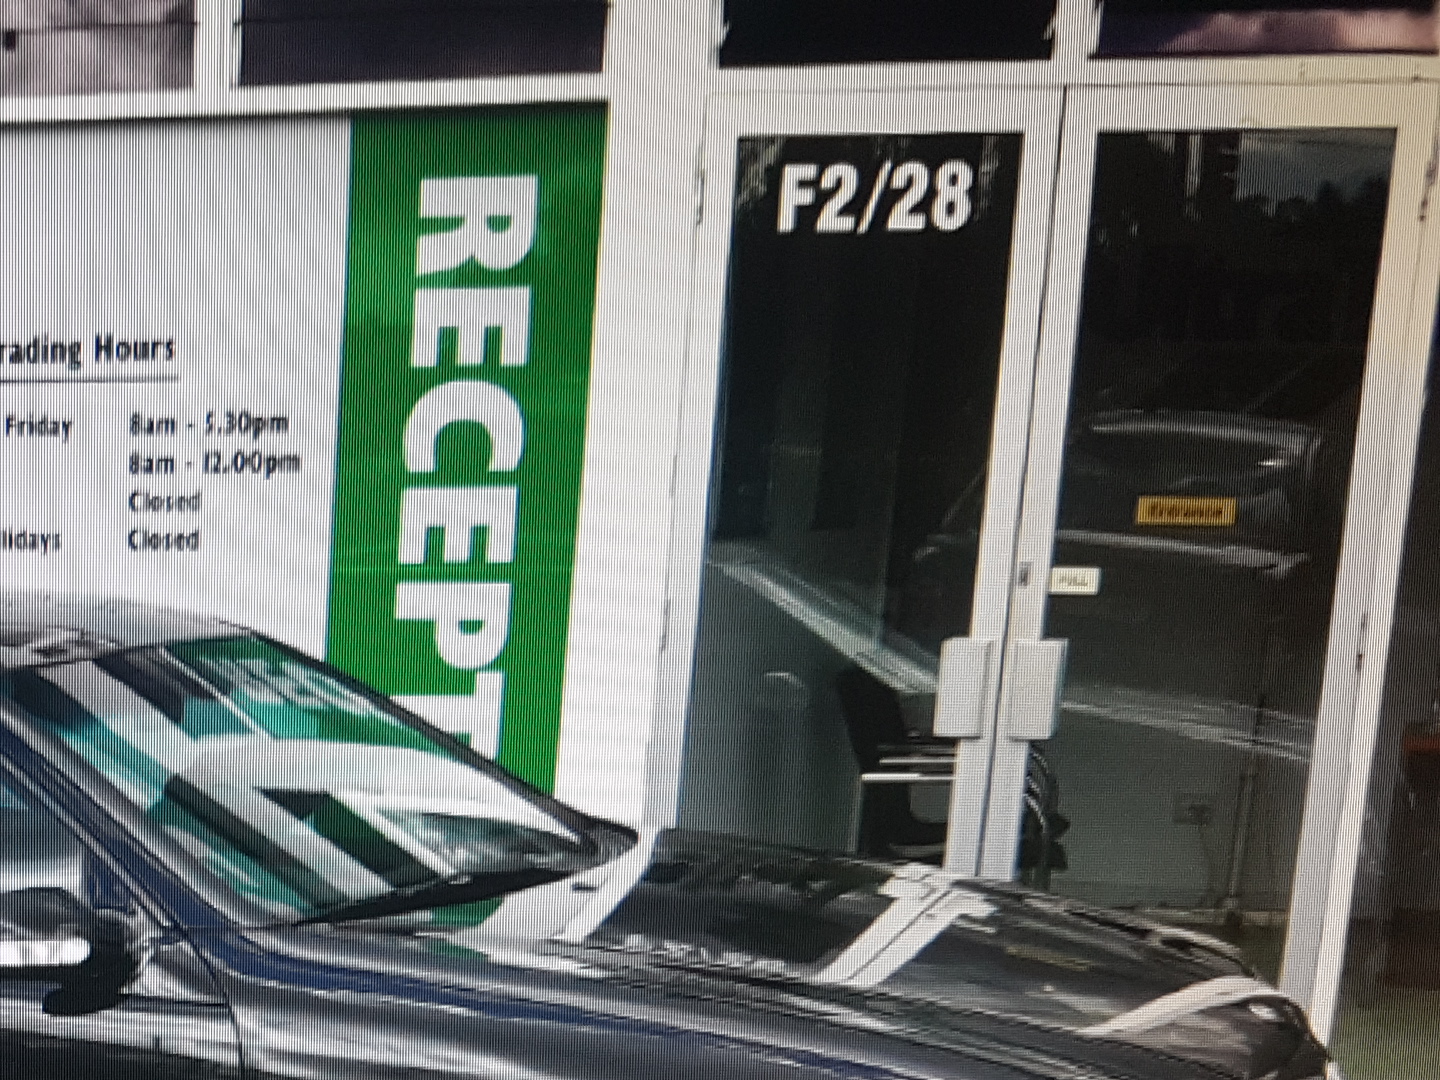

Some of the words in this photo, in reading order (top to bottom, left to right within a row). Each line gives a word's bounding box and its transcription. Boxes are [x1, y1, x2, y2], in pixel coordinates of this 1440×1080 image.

[776, 160, 976, 234] F2/28
[94, 334, 175, 363] Hours
[5, 415, 72, 442] Friday
[129, 412, 175, 435] 8am
[205, 411, 289, 440] 5.30pm
[129, 451, 175, 474] 8am
[203, 450, 301, 479] 12.00pm
[128, 491, 202, 513] Closed
[127, 528, 201, 551] Closed
